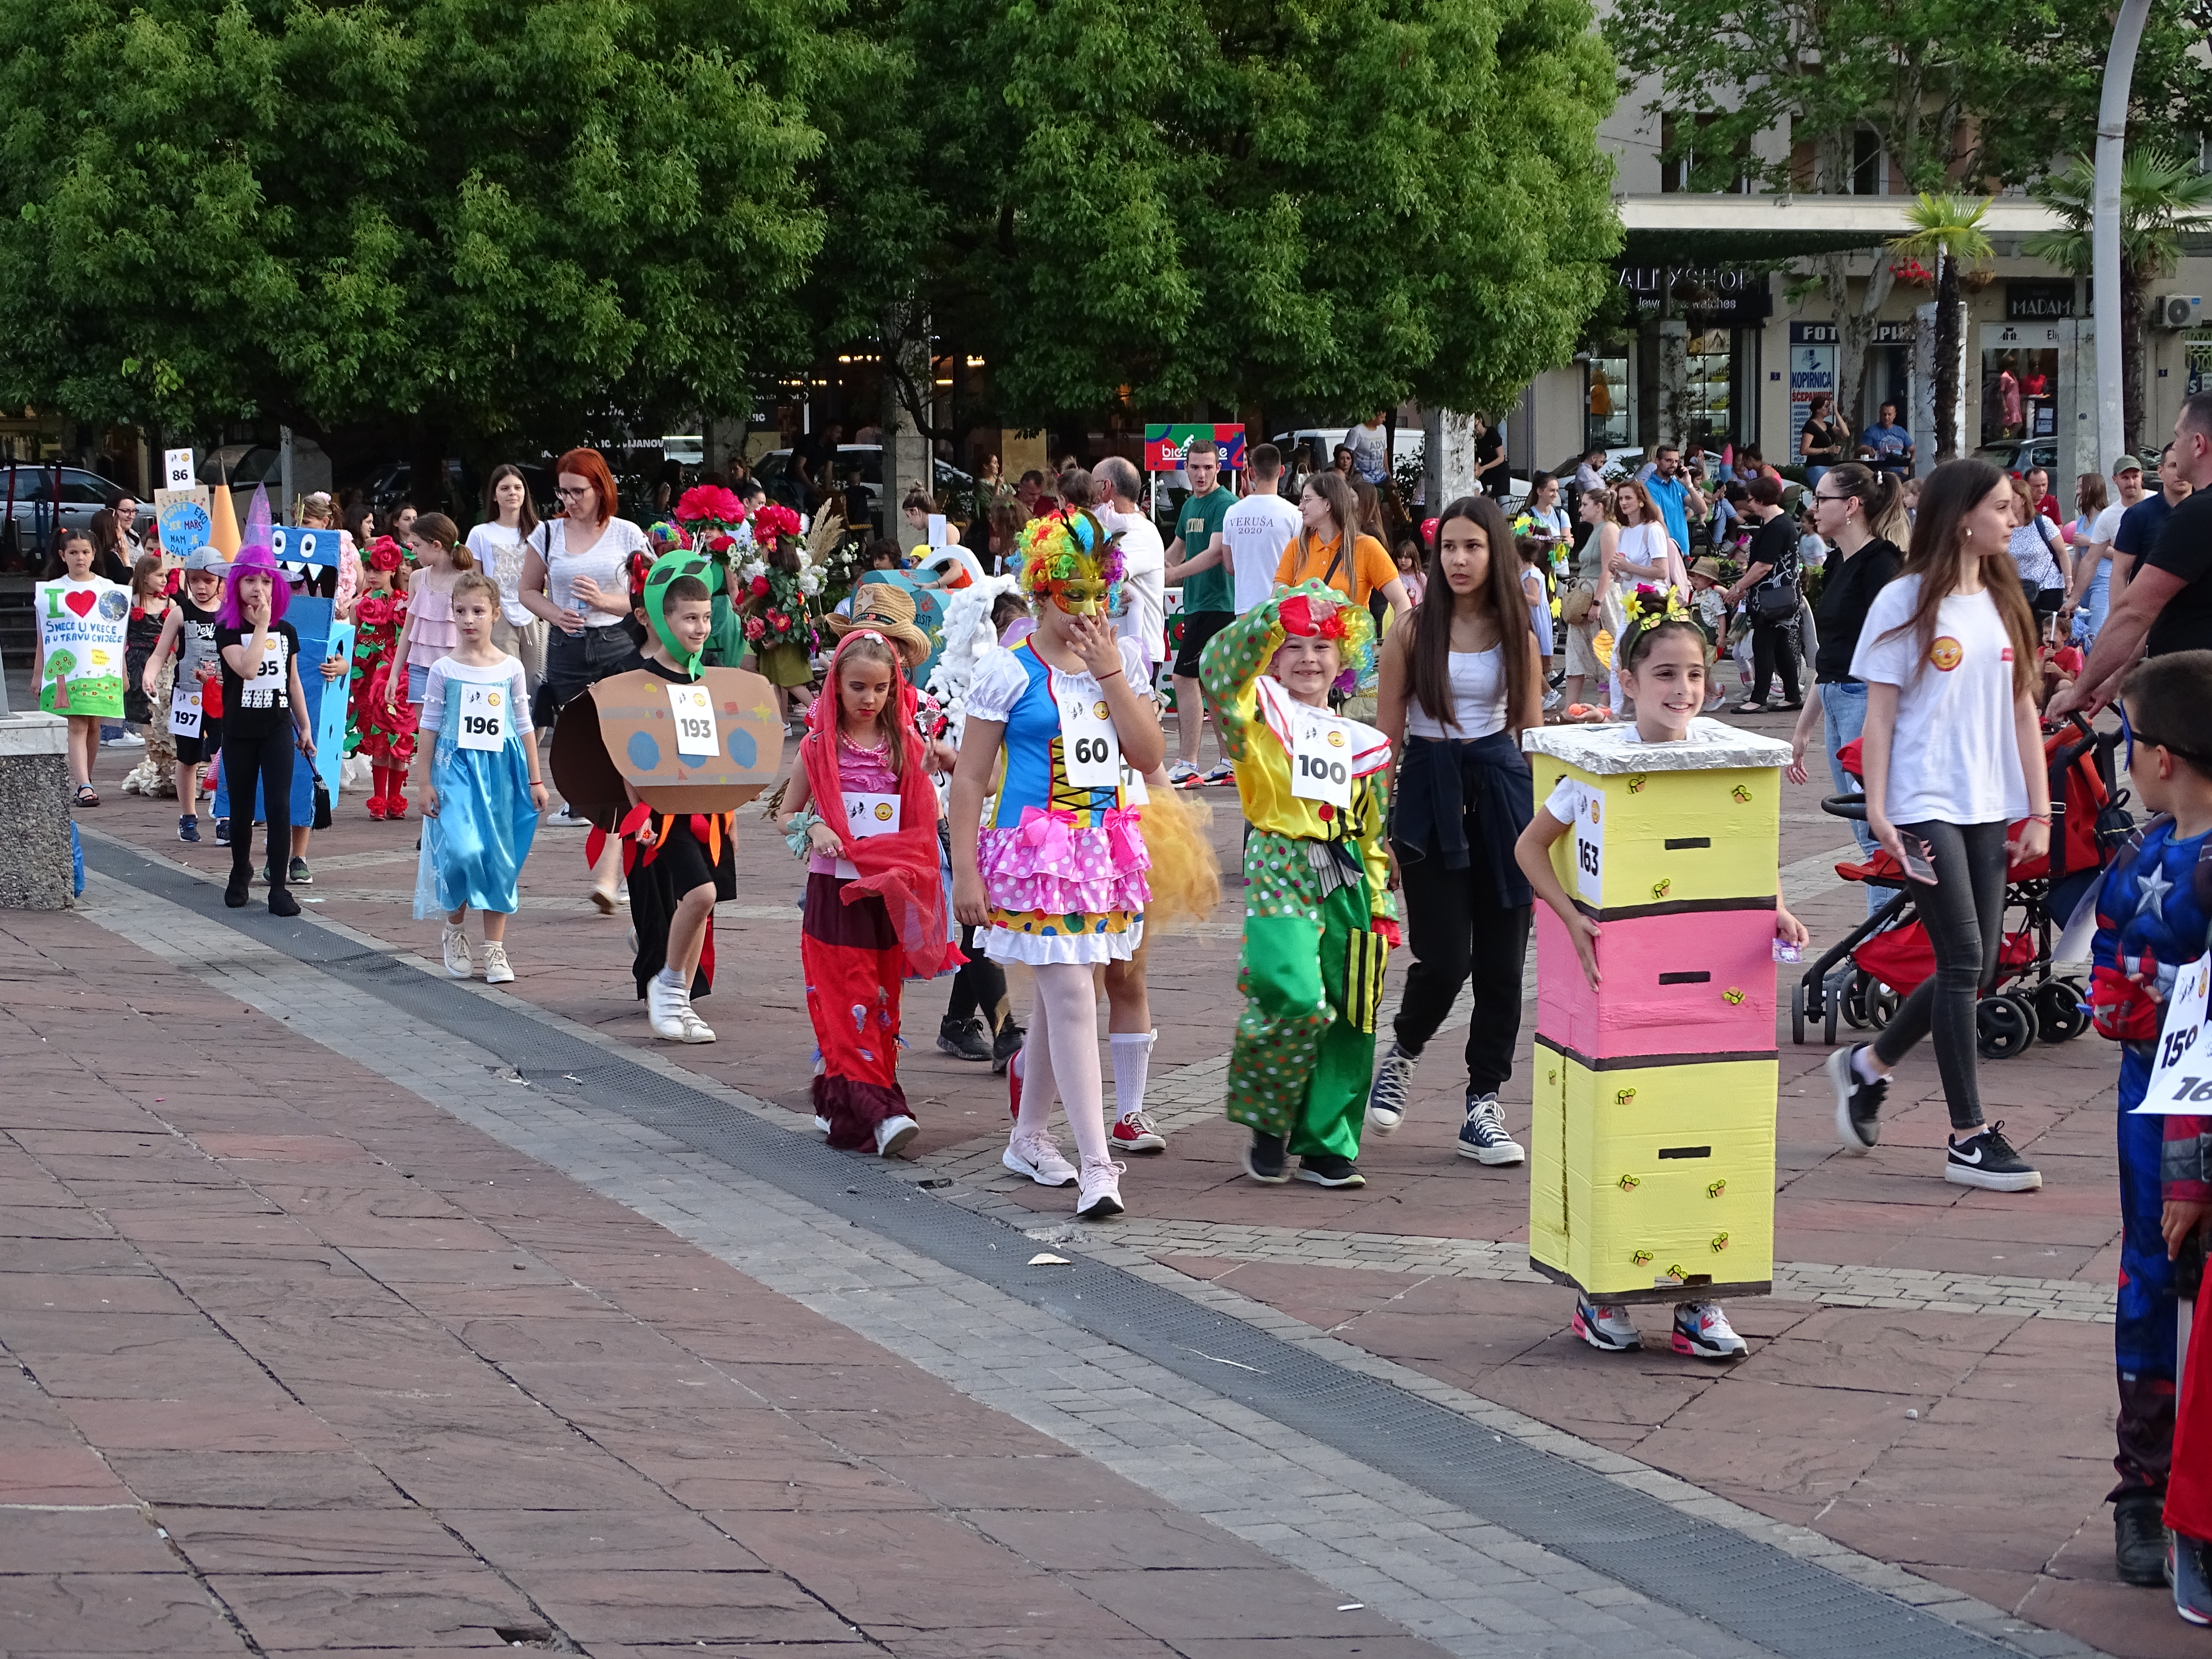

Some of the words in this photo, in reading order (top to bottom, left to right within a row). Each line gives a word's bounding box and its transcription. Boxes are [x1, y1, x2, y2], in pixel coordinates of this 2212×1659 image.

[1692, 297, 1736, 309] watches
[1792, 371, 1832, 389] KOPIRNICA
[172, 469, 189, 481] 86
[194, 506, 208, 525] EKO
[1230, 515, 1274, 528] VERUŠA
[168, 520, 181, 531] JER
[184, 519, 203, 531] MARS
[170, 534, 186, 545] NAM
[190, 534, 198, 545] JE
[44, 588, 65, 619] I
[79, 622, 87, 632] U
[45, 635, 50, 645] A
[60, 633, 90, 642] TRAVU
[175, 711, 198, 726] 197
[464, 716, 499, 736] 196
[681, 718, 711, 739] 193
[1075, 737, 1109, 764] 60
[1298, 754, 1347, 785] 100
[1579, 838, 1599, 876] 163
